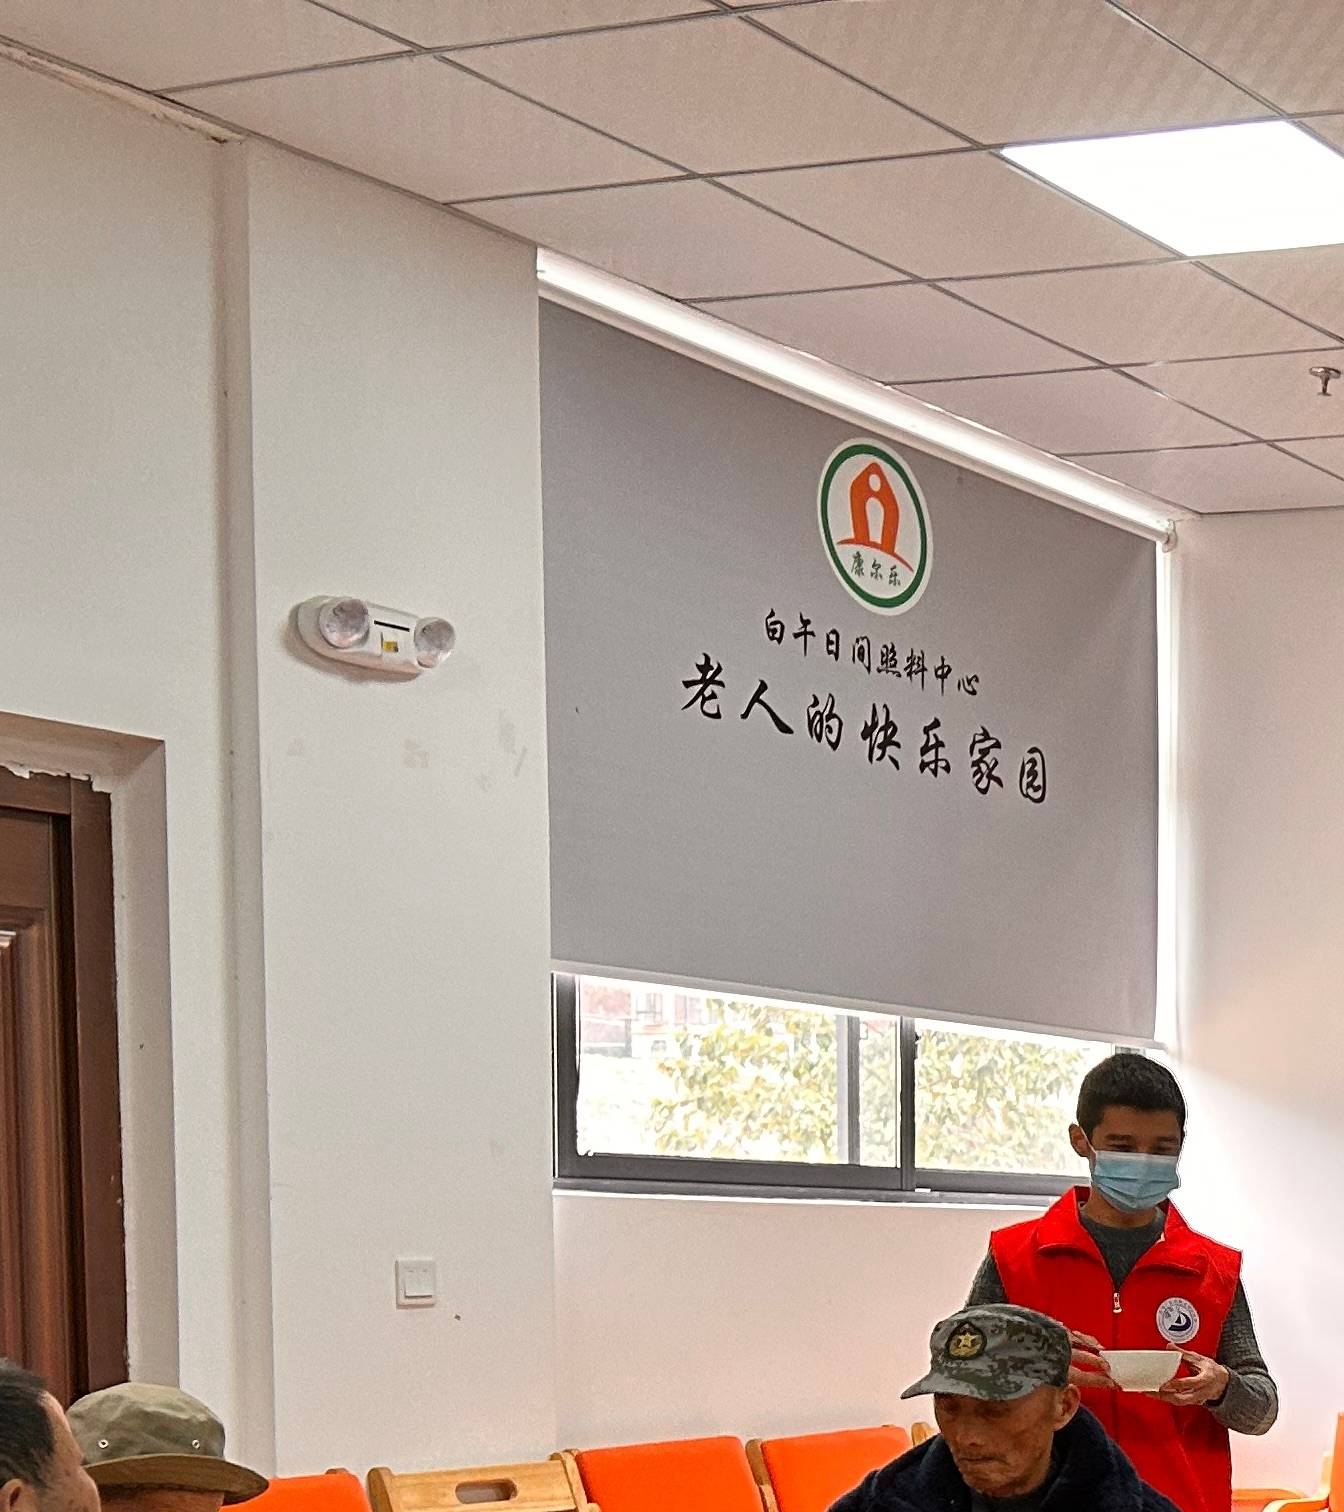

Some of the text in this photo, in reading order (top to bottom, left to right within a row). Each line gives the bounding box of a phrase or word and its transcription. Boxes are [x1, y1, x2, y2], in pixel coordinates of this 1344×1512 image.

[851, 550, 901, 586] 康尔乐
[764, 608, 980, 696] 白午日间照料中心
[680, 652, 1049, 806] 老人的快乐家园
